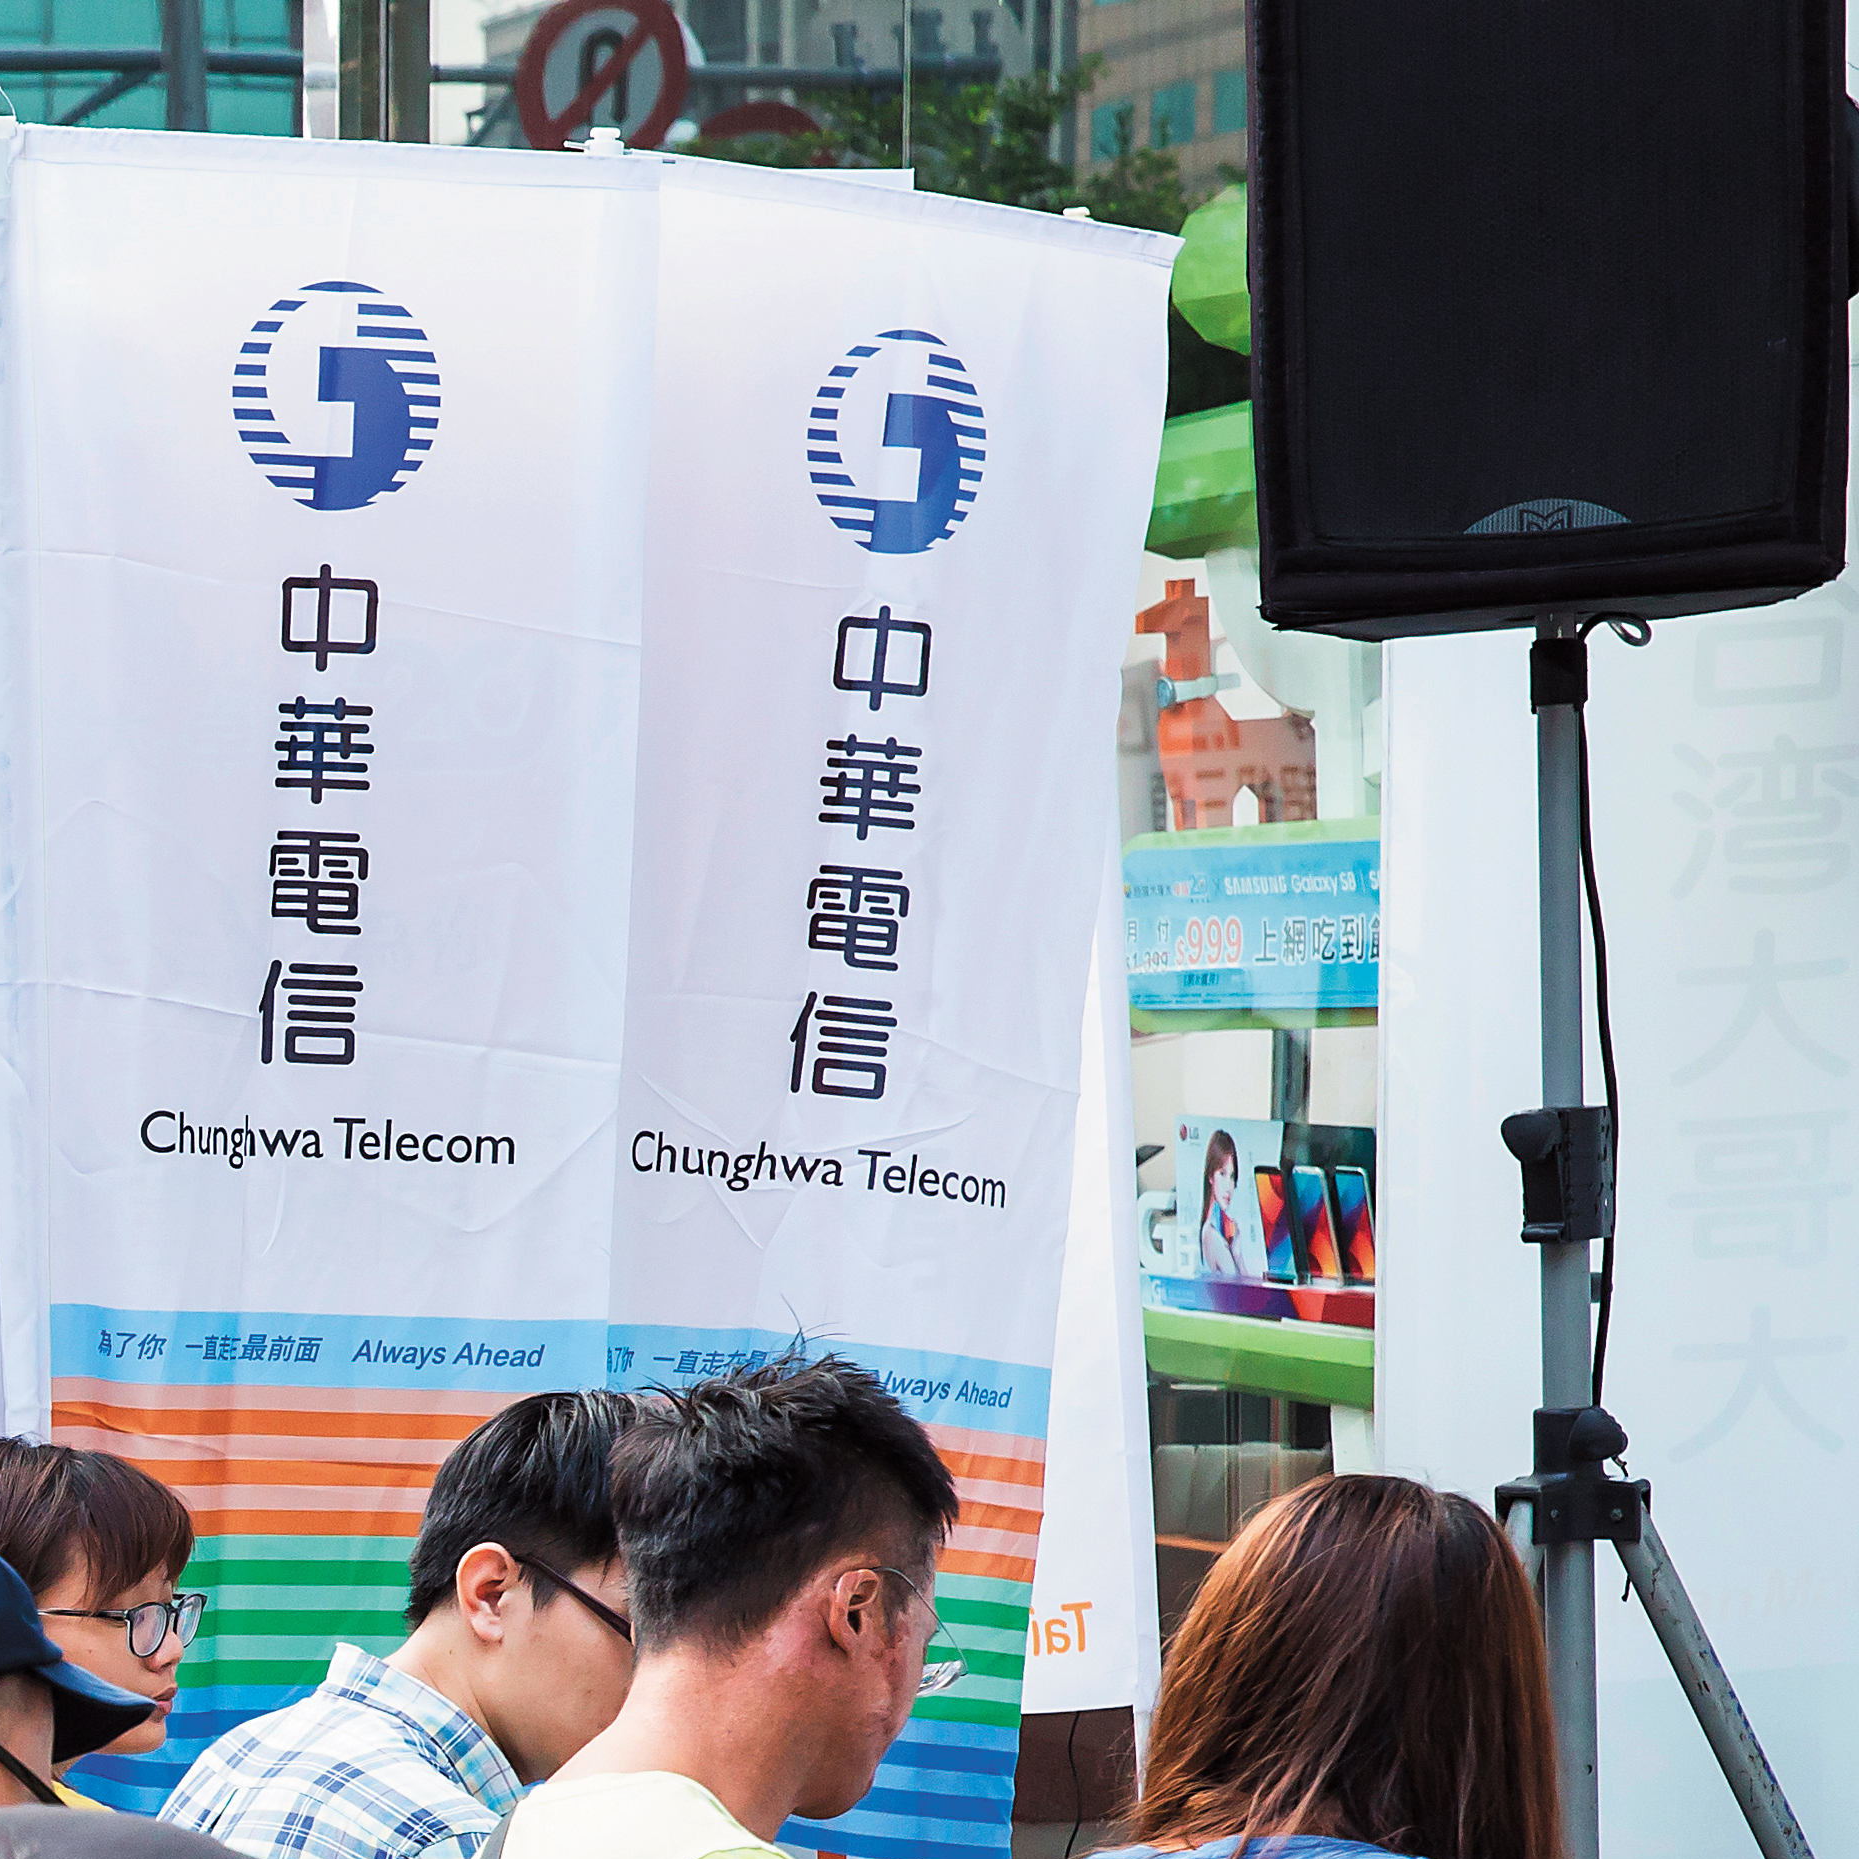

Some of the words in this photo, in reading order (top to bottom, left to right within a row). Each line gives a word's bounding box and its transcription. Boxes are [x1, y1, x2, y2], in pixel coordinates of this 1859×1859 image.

[257, 562, 380, 1067] 中華電信
[788, 604, 933, 1101] 中華電信
[1224, 876, 1287, 895] SAMSUNG
[1291, 874, 1338, 896] Galaxy
[1176, 917, 1242, 965] $999
[139, 1109, 325, 1171] Chunghwa
[332, 1116, 516, 1166] Telecom
[630, 1129, 845, 1193] Chunghwa
[856, 1148, 1007, 1210] Telecom
[350, 1338, 448, 1371] Always
[451, 1341, 546, 1368] Ahead
[873, 1370, 952, 1403] lways
[954, 1379, 1014, 1409] Ahead
